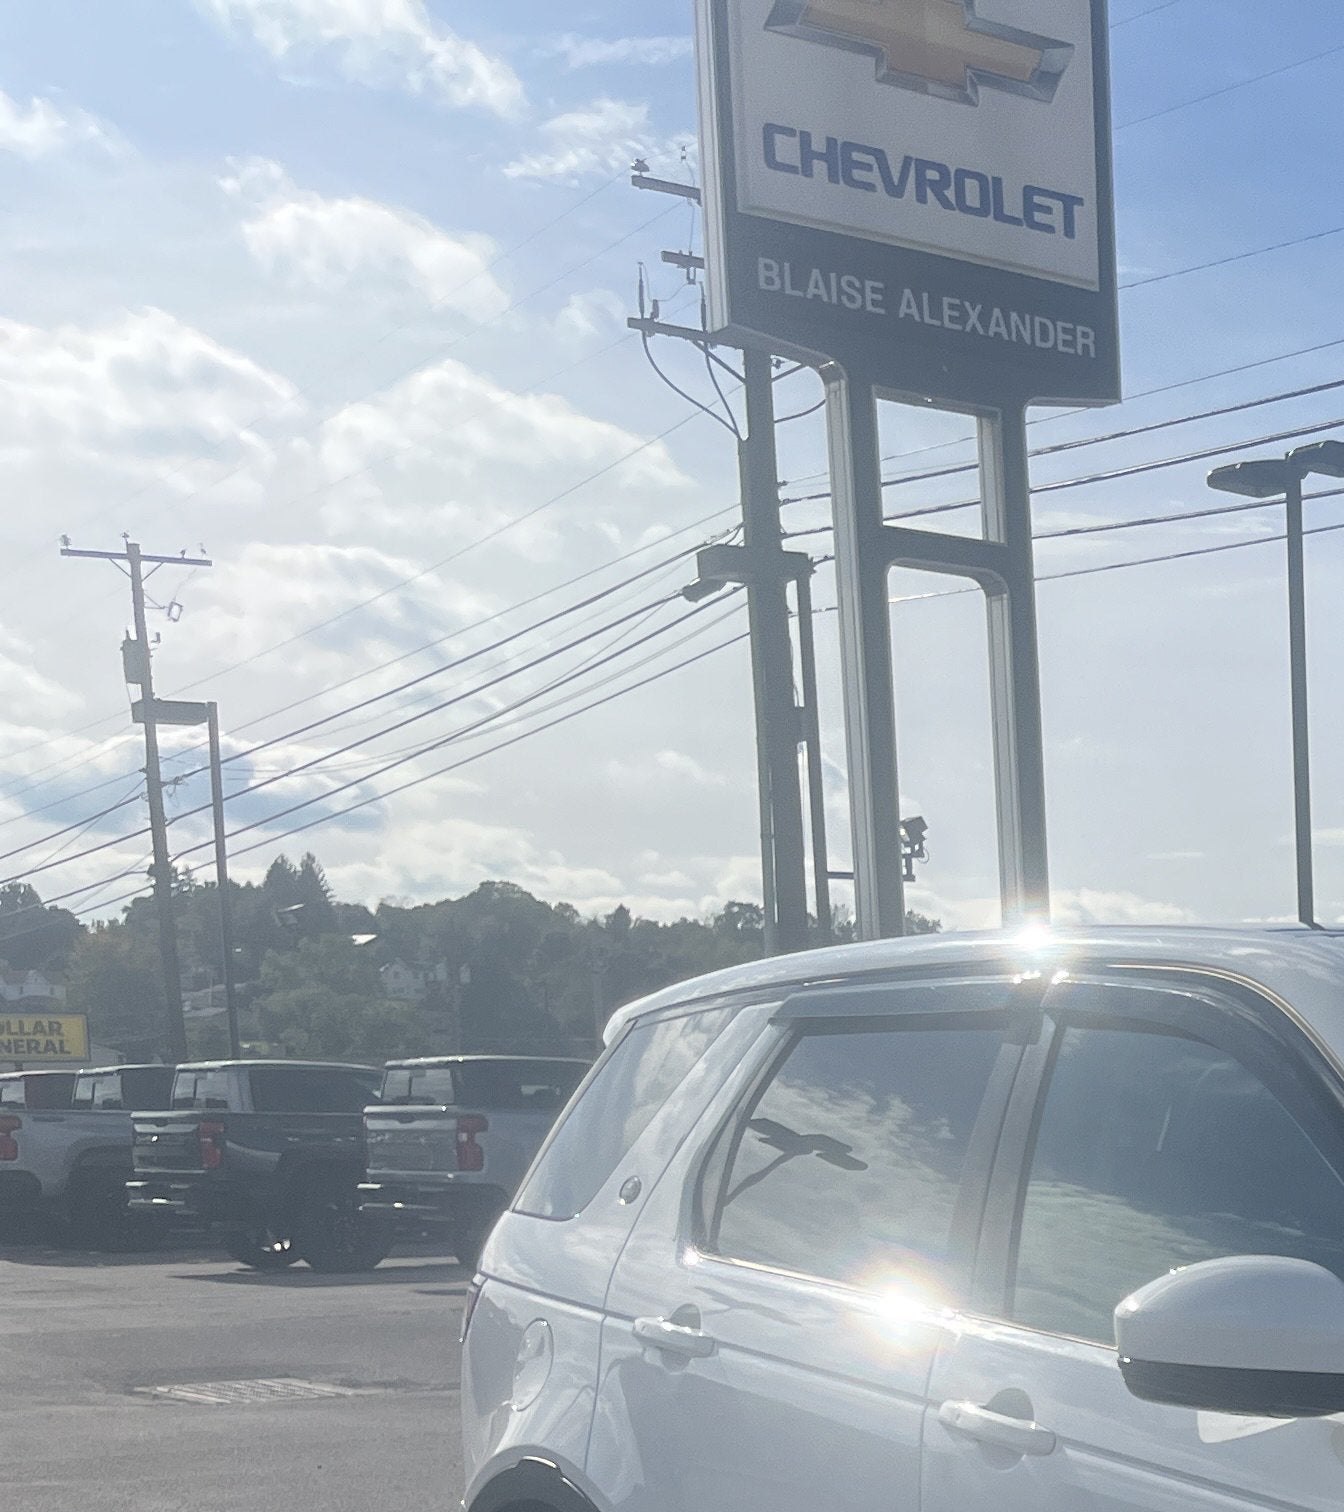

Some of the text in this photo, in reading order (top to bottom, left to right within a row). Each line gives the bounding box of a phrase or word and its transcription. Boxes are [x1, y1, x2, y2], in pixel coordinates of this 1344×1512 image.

[762, 123, 1084, 239] CHEVROLET
[758, 257, 1097, 359] BLAISE ALEXANDER
